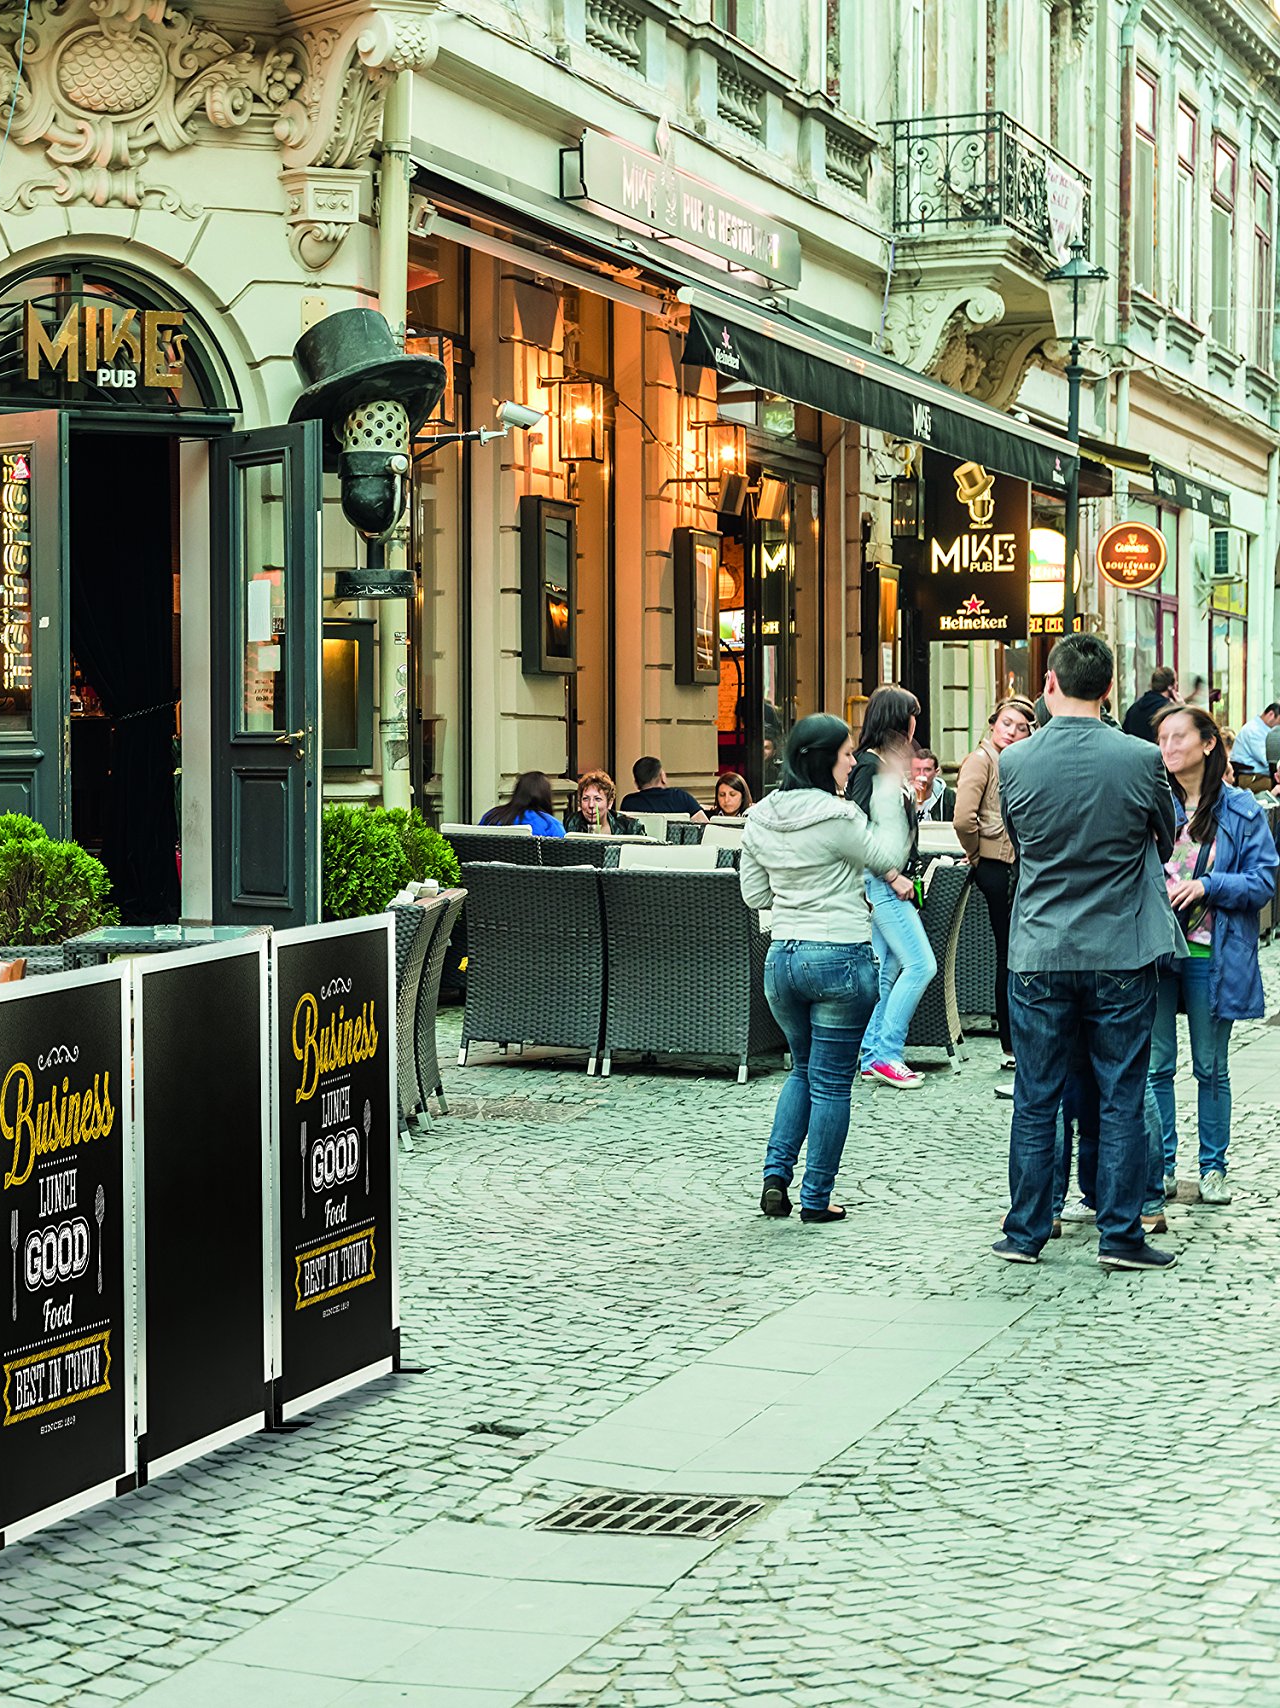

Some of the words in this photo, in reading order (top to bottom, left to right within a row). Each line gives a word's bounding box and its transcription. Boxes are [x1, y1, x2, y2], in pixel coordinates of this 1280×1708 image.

[97, 368, 137, 388] PUB
[970, 562, 993, 573] PUB
[940, 614, 1009, 631] Heineken
[292, 992, 378, 1104] Business
[0, 1062, 115, 1190] Business
[322, 1085, 351, 1128] LUNCH
[311, 1130, 359, 1190] GOOD
[38, 1168, 78, 1218] LUNCH
[324, 1195, 348, 1229] Food
[25, 1219, 89, 1288] GOOD
[304, 1254, 327, 1297] BEST
[328, 1250, 339, 1287] IN
[340, 1239, 368, 1282] TOWN
[42, 1294, 73, 1332] Food
[15, 1364, 46, 1411] BEST
[48, 1357, 62, 1399] IN
[65, 1344, 101, 1393] TOWN
[40, 1420, 63, 1435] SINCE
